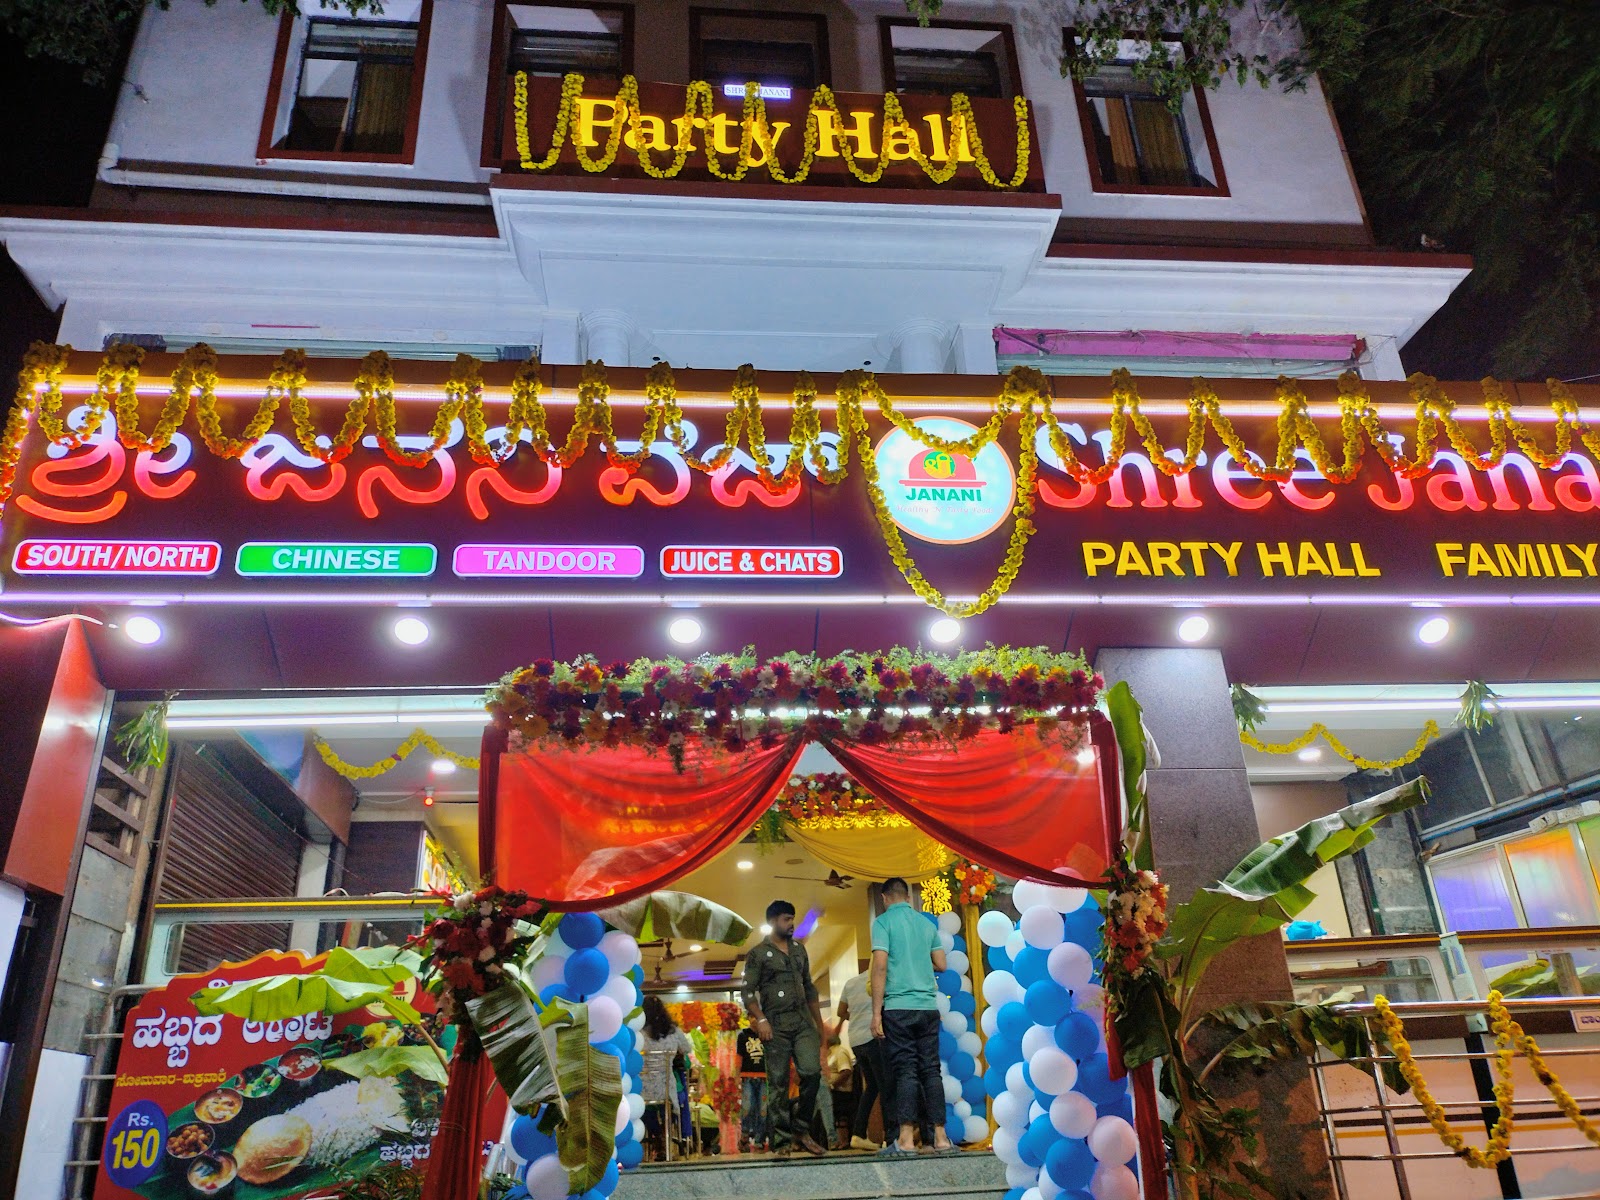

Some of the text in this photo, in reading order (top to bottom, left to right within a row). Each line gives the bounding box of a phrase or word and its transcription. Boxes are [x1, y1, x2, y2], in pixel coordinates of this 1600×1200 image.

[575, 97, 976, 167] Party Hall
[15, 405, 197, 524] ಶ್ರೀ
[1034, 421, 1600, 512] Shree Jana
[905, 487, 982, 502] JANANI
[25, 544, 210, 571] SOUTH/NORTH
[272, 548, 401, 571] CHINESE
[482, 550, 616, 571] TANDOOR
[670, 551, 833, 573] JUICE & CHATS
[1081, 541, 1382, 577] PARTY HALL
[1435, 542, 1599, 577] FAMILY
[132, 1007, 224, 1069] ಹಬ್ಬದ
[128, 1112, 154, 1127] Rs.
[112, 1127, 160, 1169] 150
